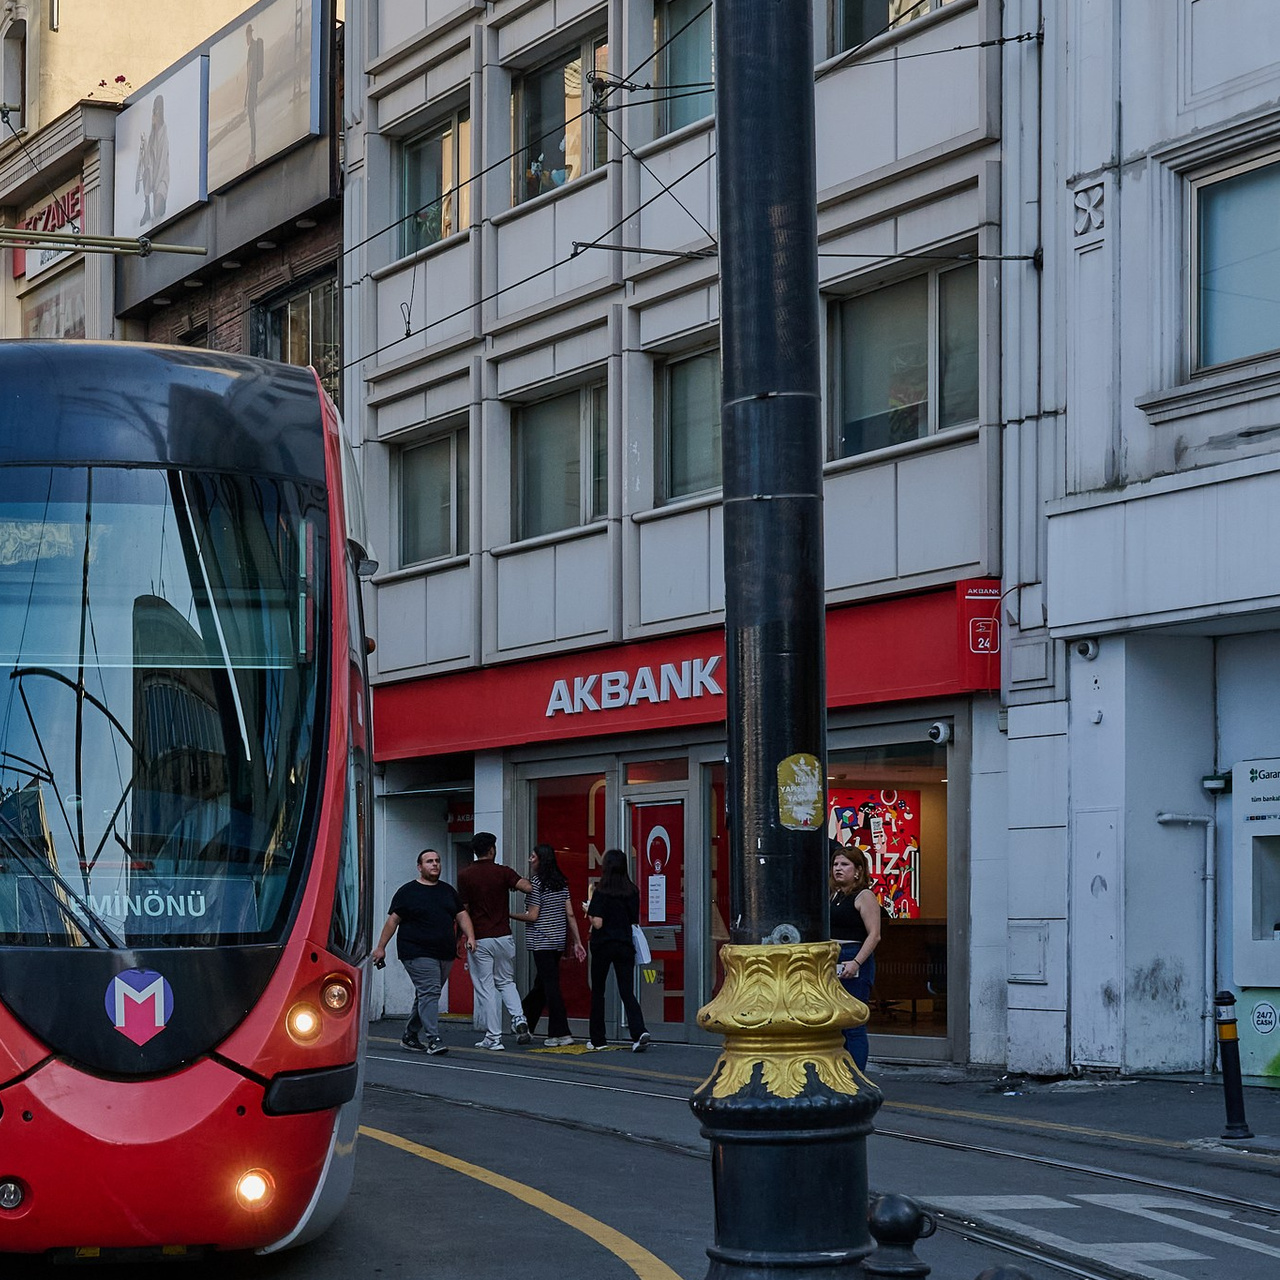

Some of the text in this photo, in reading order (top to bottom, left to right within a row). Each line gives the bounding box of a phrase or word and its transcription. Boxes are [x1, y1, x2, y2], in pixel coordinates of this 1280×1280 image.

[978, 637, 990, 649] 24
[545, 655, 724, 717] AKBANK
[71, 890, 206, 917] EMİNÖNÜ
[1256, 1011, 1273, 1019] 24/7
